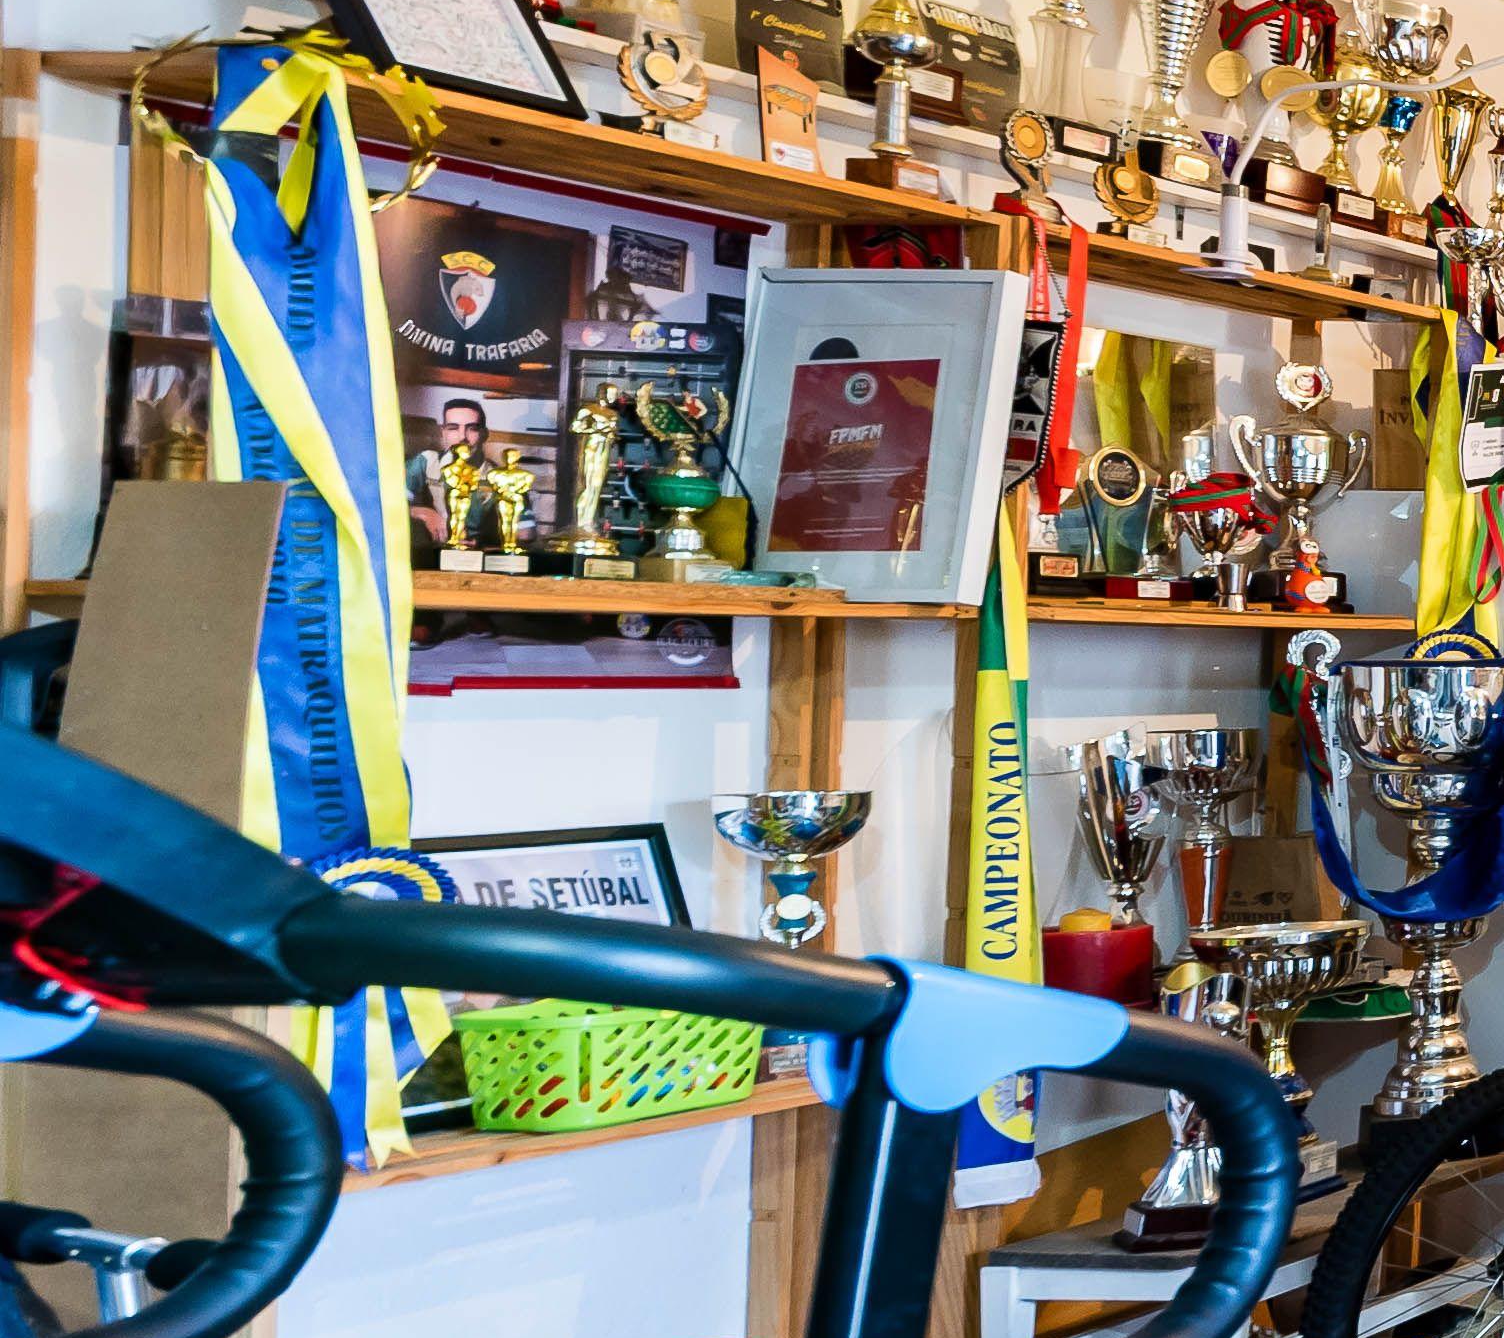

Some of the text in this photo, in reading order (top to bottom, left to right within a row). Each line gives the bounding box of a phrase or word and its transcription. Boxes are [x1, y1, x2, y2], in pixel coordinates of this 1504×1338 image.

[465, 327, 551, 362] TRAFARIA
[980, 721, 1020, 962] CAMPEONATO
[473, 868, 650, 911] DE SETÚBAL
